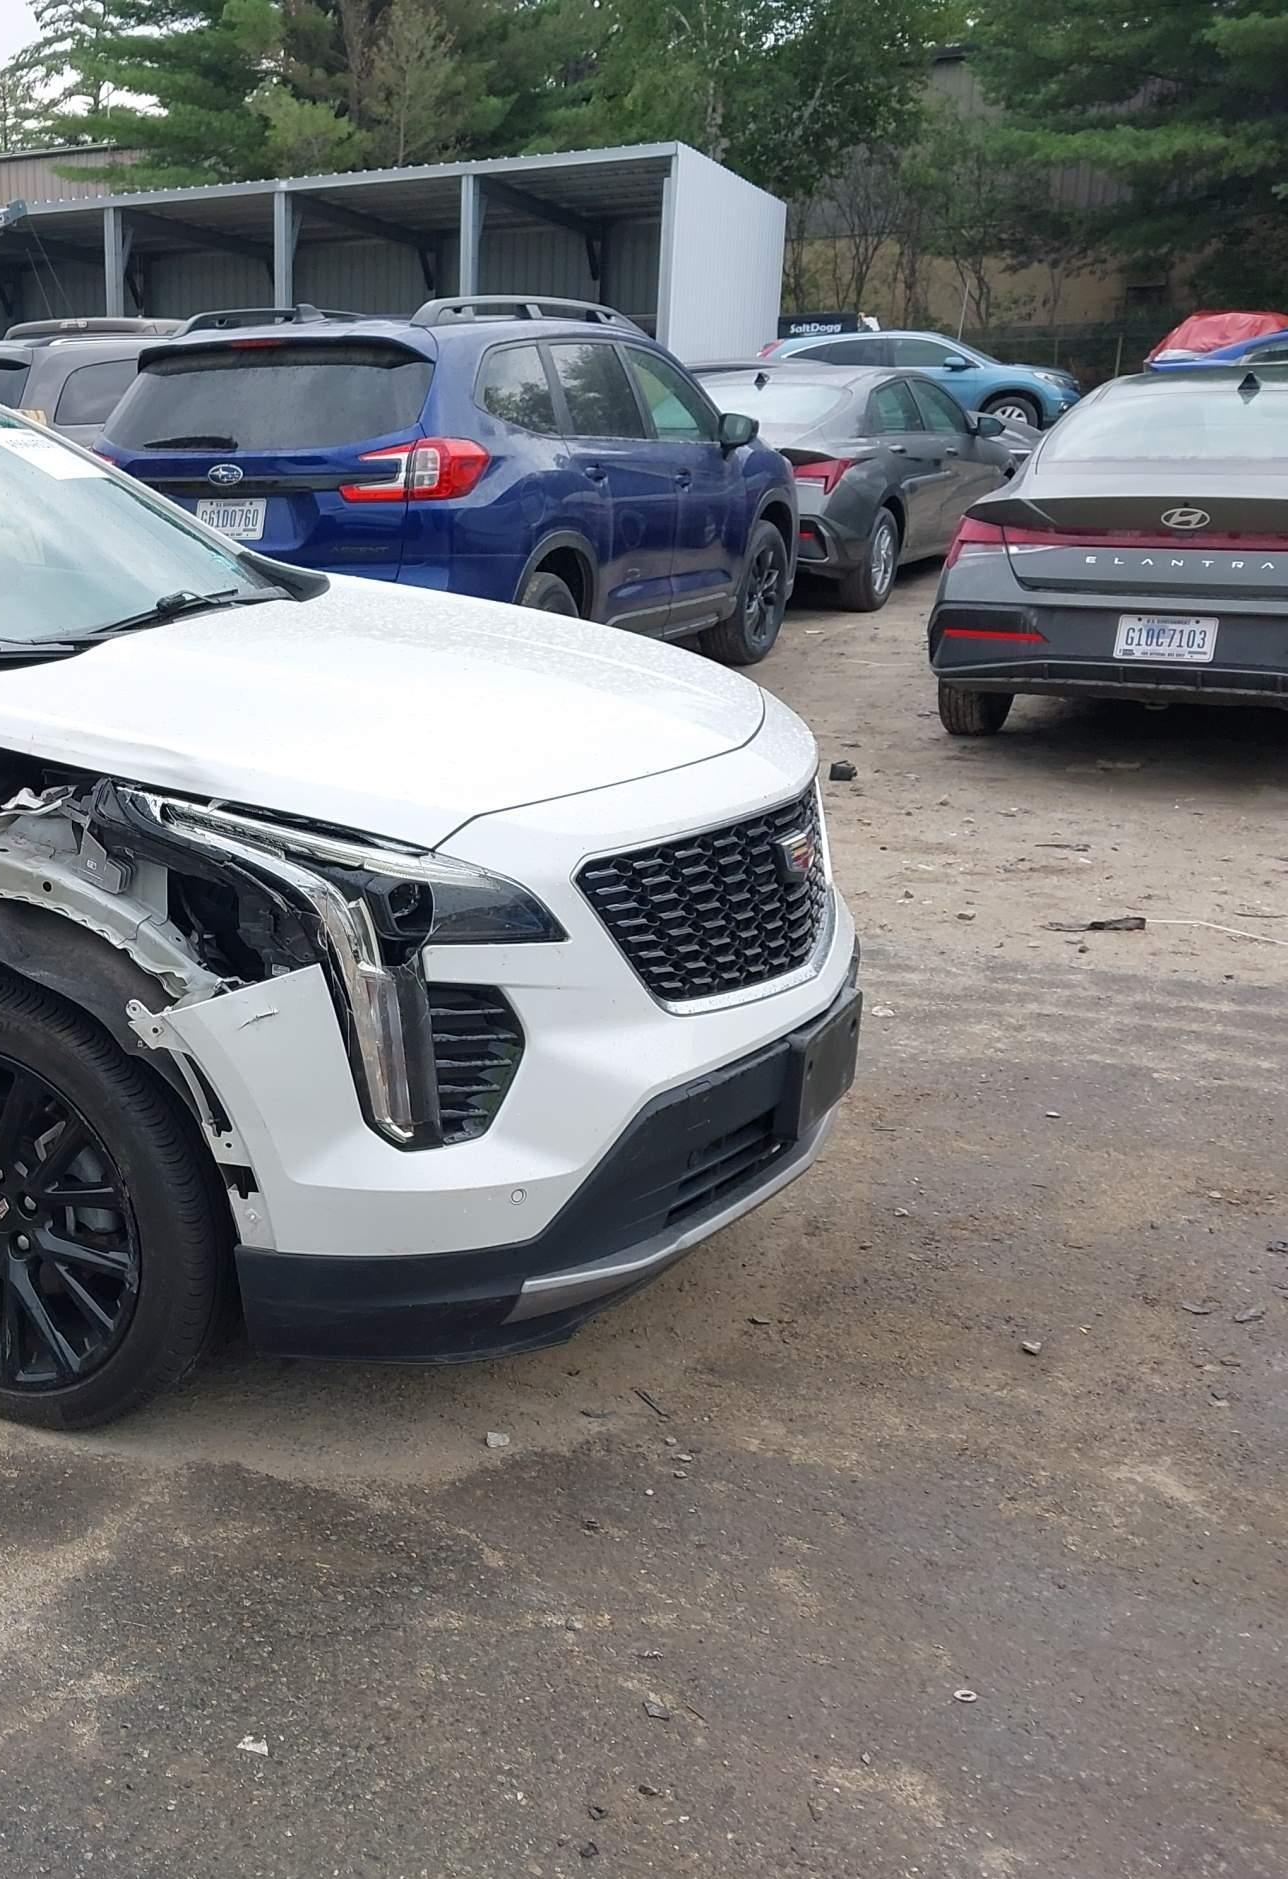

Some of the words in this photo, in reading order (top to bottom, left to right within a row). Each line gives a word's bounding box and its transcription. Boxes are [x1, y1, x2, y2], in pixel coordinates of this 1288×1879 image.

[790, 322, 842, 333] SaltDogg
[200, 509, 259, 528] G61D0760
[1085, 556, 1275, 570] ELANTRA
[1125, 627, 1207, 649] G10C7103
